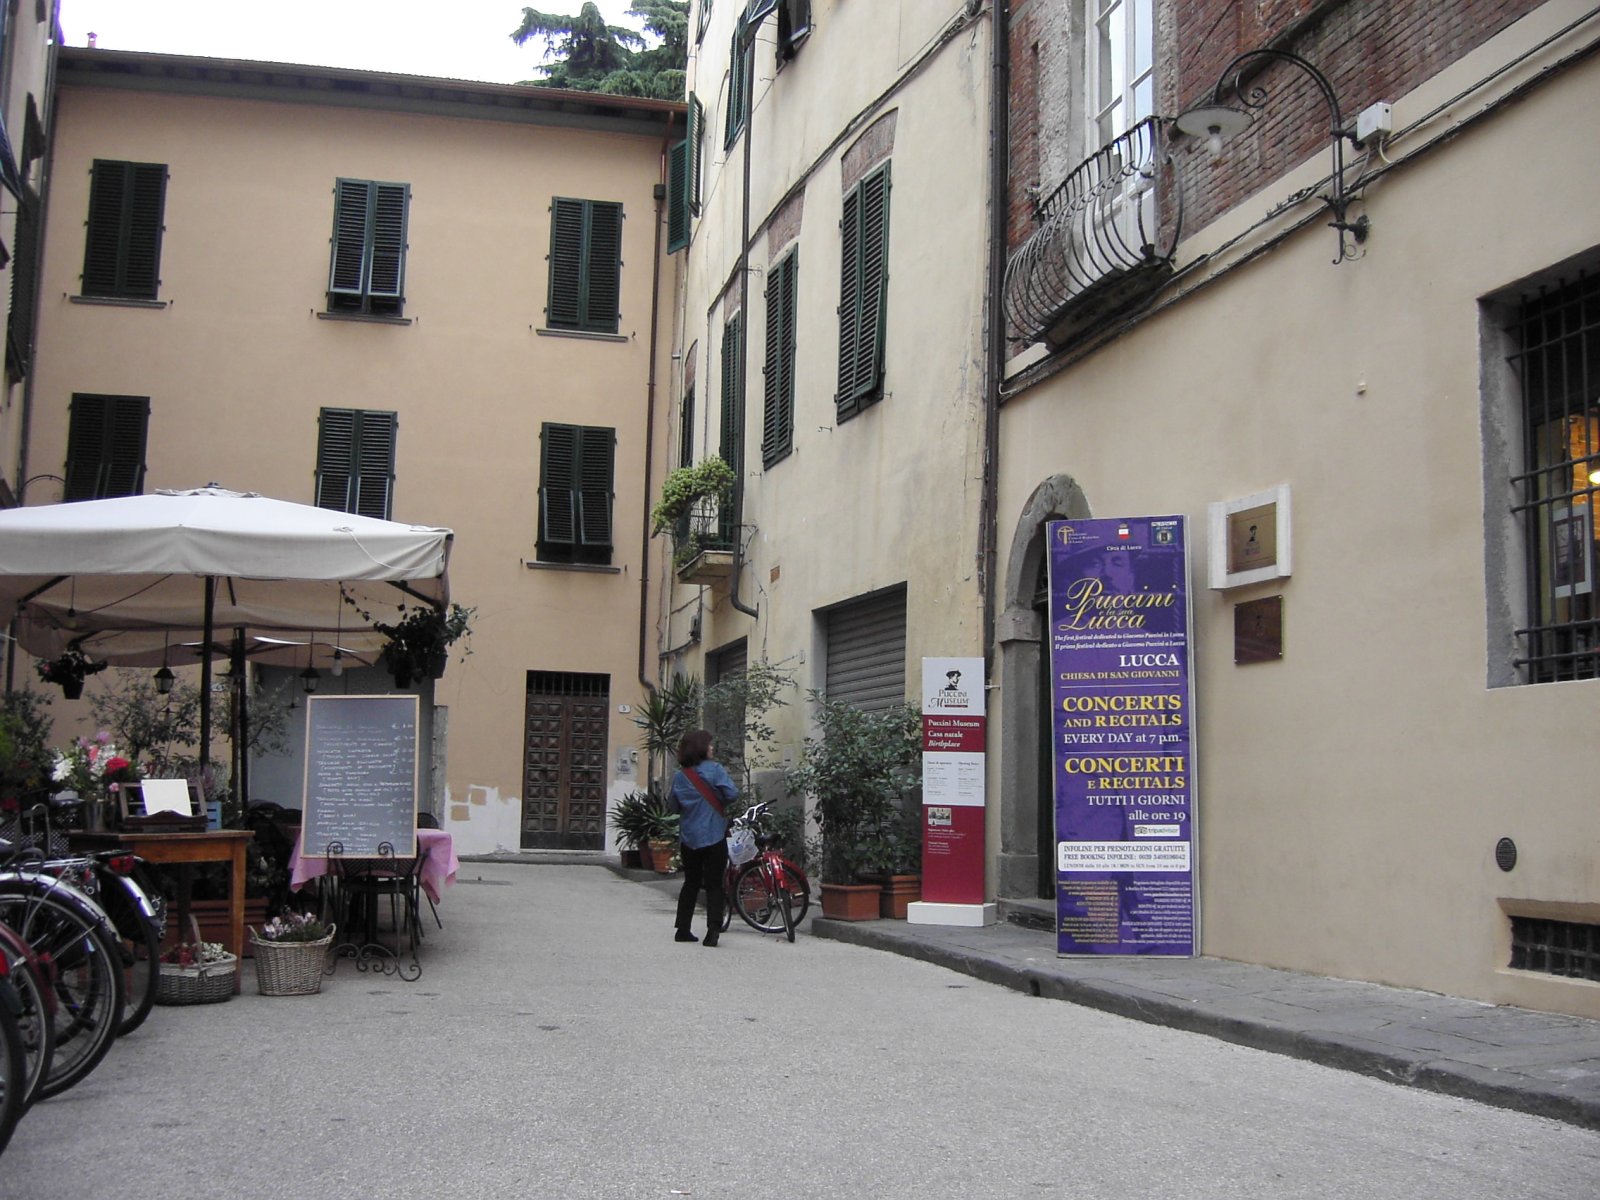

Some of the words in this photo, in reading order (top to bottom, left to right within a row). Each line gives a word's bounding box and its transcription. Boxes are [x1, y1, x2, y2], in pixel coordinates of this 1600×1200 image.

[1066, 578, 1176, 610] Puccini
[1058, 598, 1146, 631] Lucca
[1120, 654, 1180, 667] LUCCA
[1061, 672, 1095, 680] CHIESA
[939, 689, 967, 697] PUCCINI
[928, 697, 969, 708] MUSEUM
[1063, 695, 1182, 712] CONCERTS
[1064, 718, 1091, 728] AND
[1095, 714, 1182, 727] RECITALS
[928, 740, 960, 748] Birthplace
[1064, 733, 1105, 743] EVERY
[1108, 733, 1134, 742] DAY
[1136, 734, 1146, 742] at
[1149, 734, 1156, 744] 7
[1159, 734, 1182, 744] p.m.
[1065, 757, 1184, 773] CONCERTI
[1088, 780, 1095, 789] E
[1100, 777, 1185, 788] RECITALS
[1086, 795, 1126, 806] TUTTI
[1130, 795, 1135, 805] I
[1138, 795, 1184, 805] GIORNI
[1128, 810, 1149, 820] alle
[1151, 812, 1171, 820] ore
[1174, 812, 1186, 821] 19
